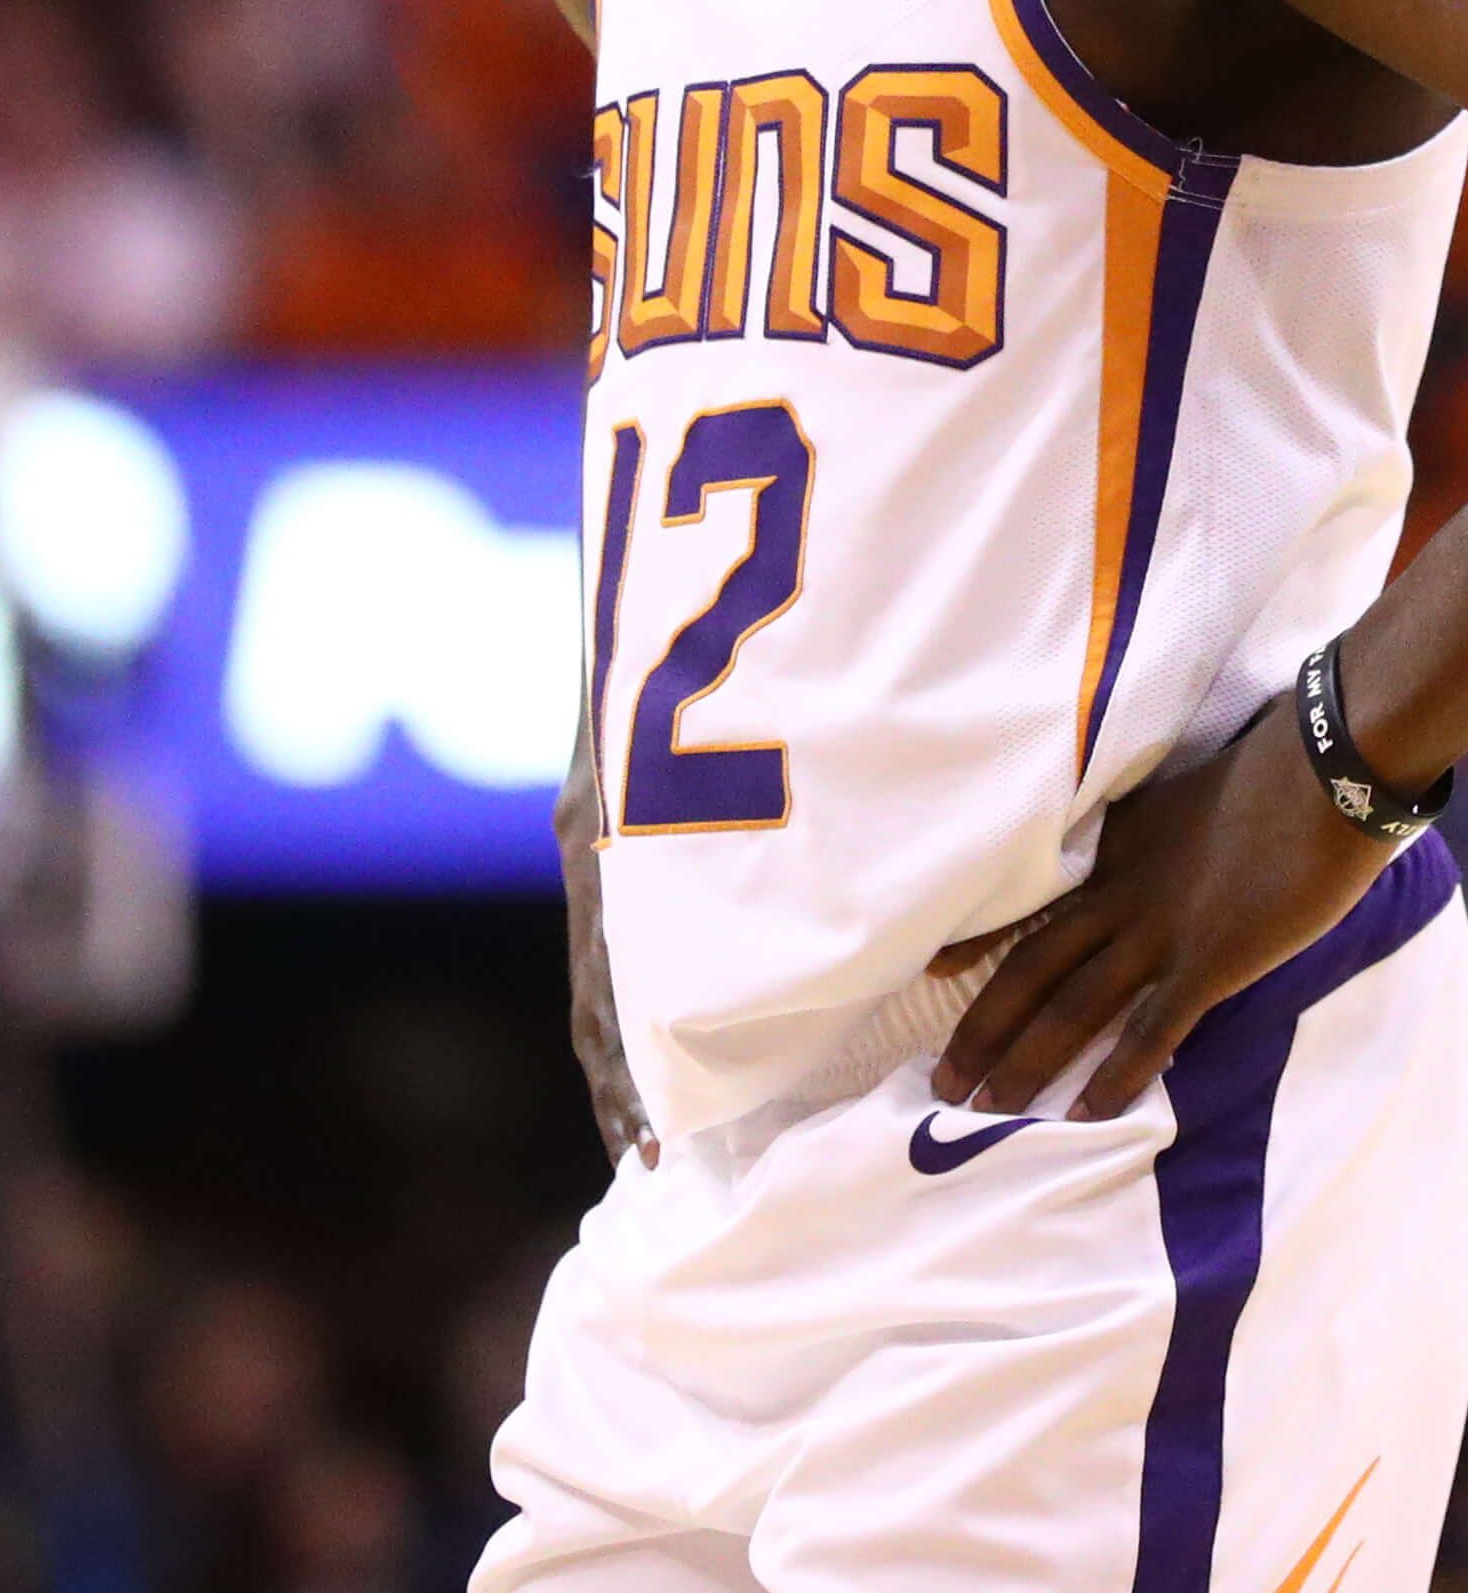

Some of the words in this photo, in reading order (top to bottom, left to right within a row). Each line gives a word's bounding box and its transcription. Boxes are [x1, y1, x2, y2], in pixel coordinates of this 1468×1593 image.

[590, 397, 817, 852] 12
[1306, 669, 1323, 698] MY
[1309, 703, 1333, 754] FOR
